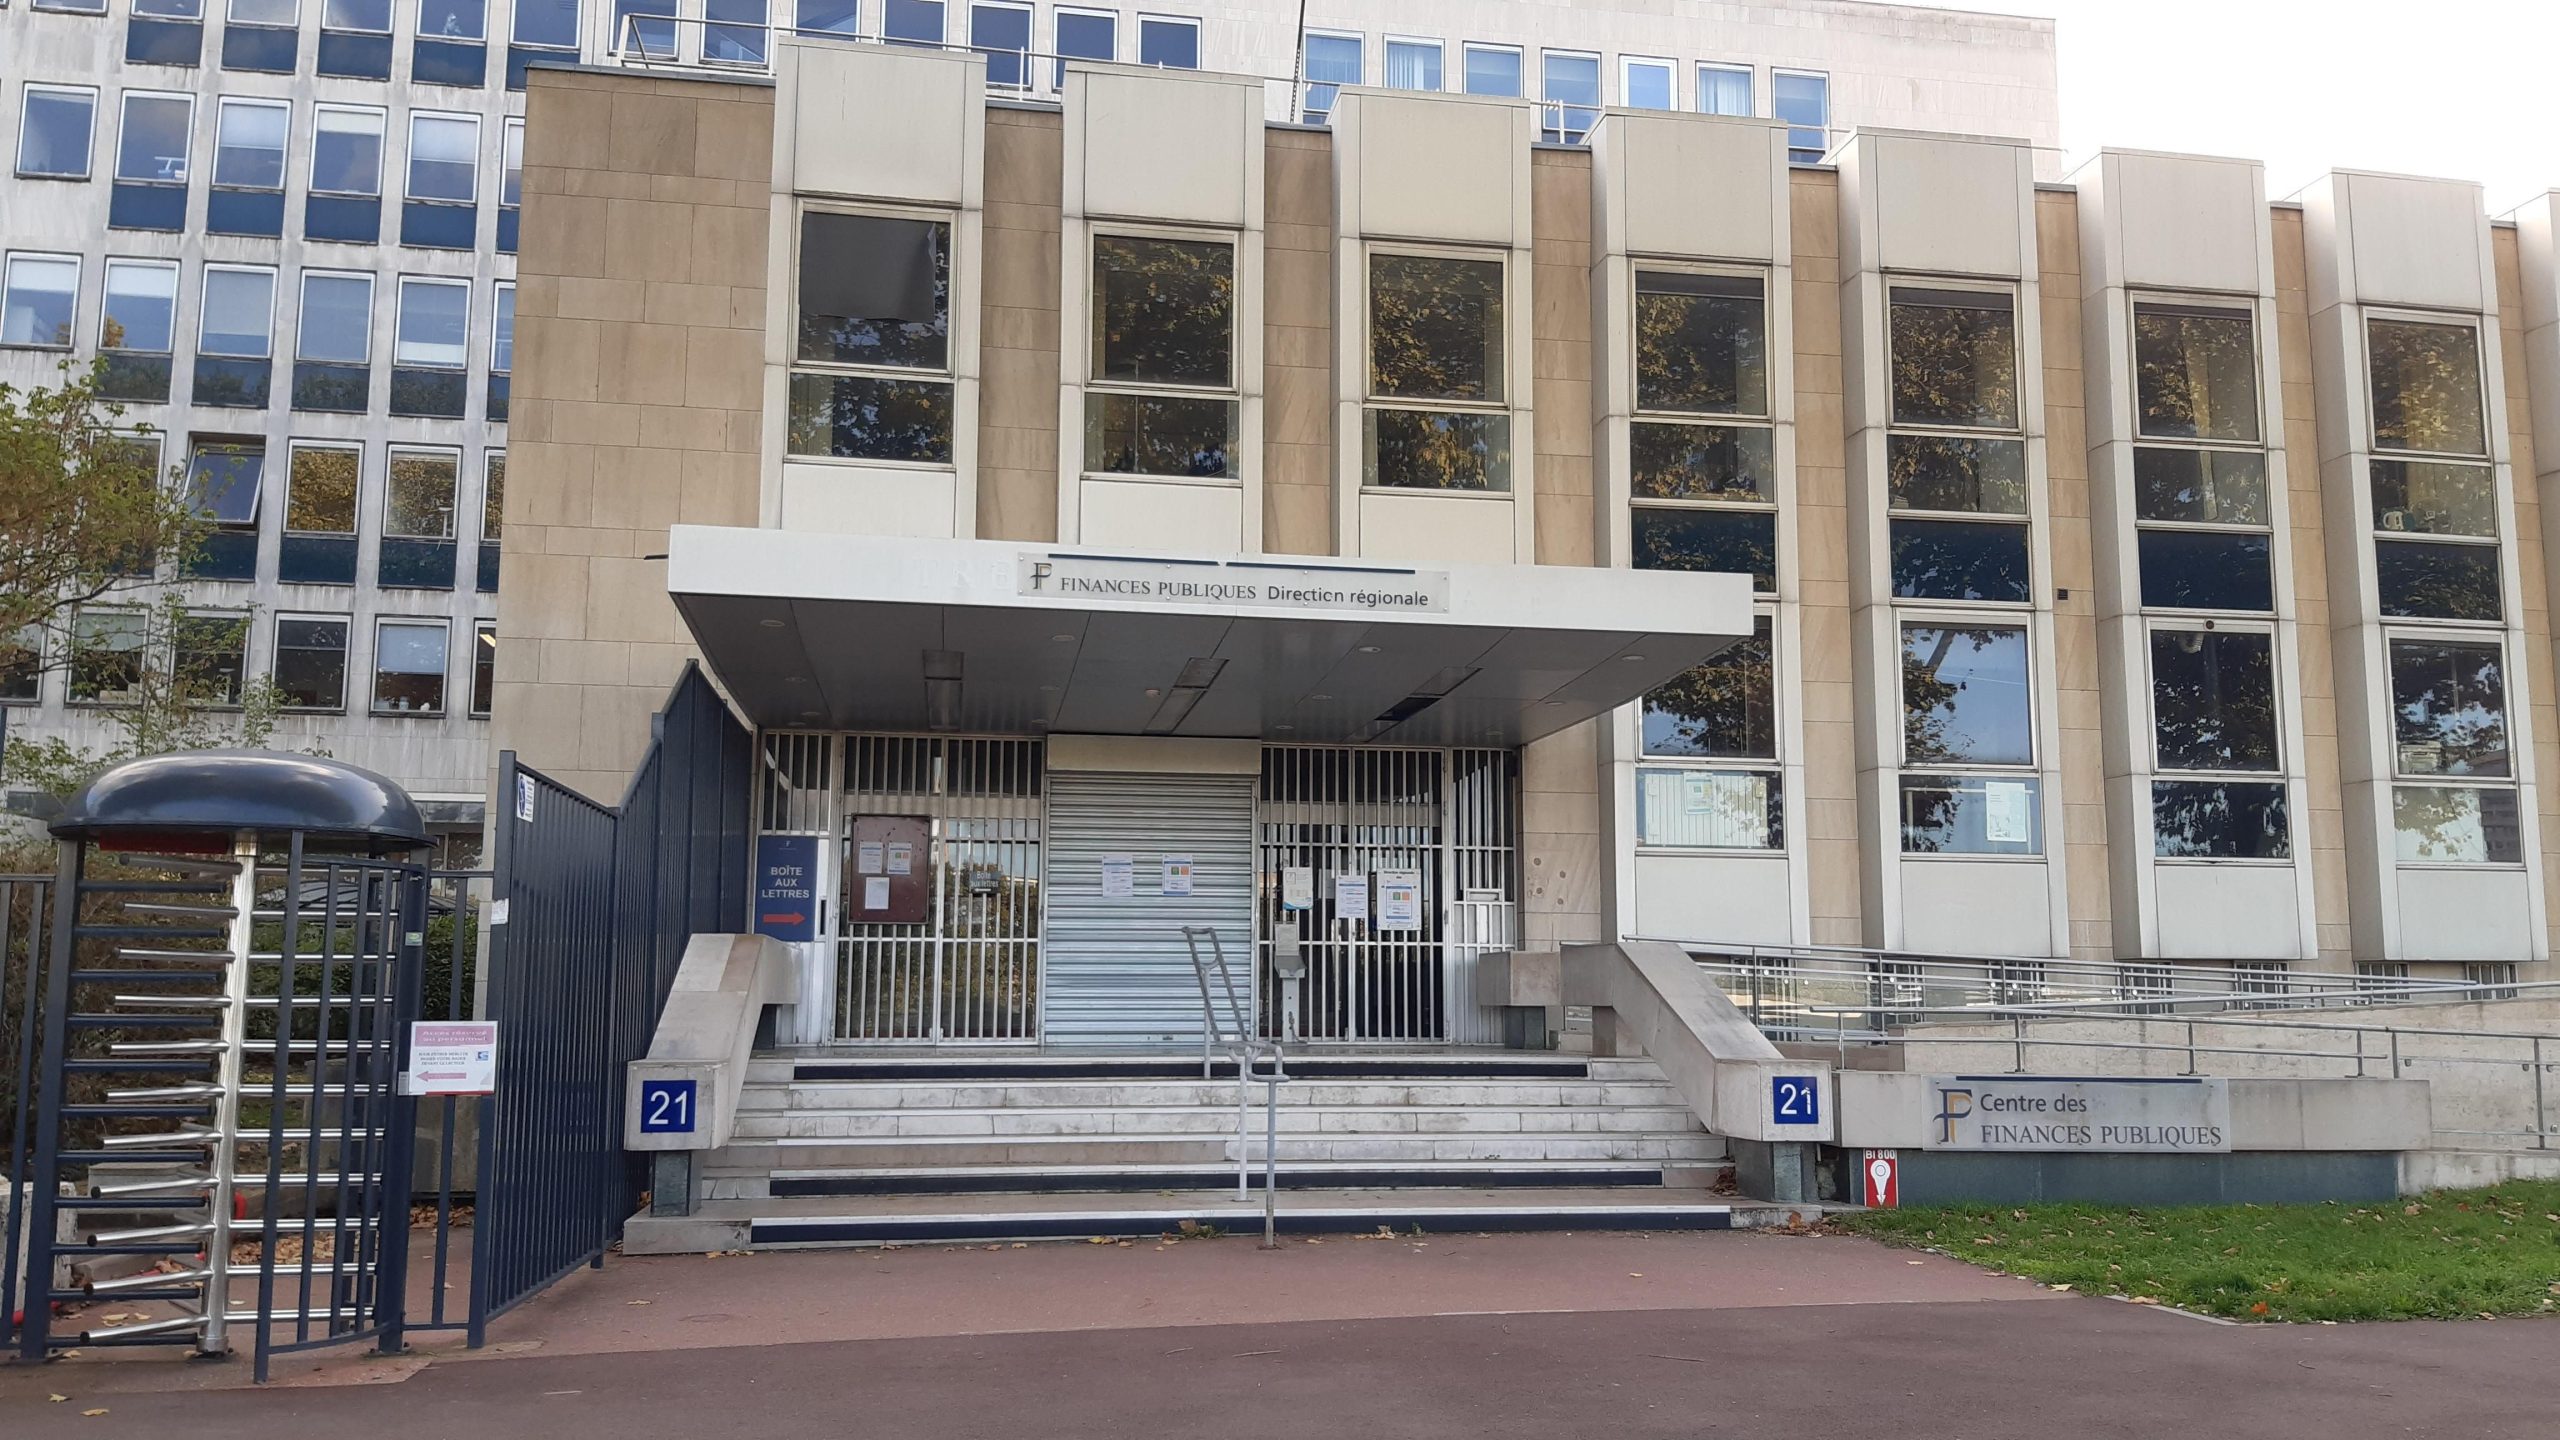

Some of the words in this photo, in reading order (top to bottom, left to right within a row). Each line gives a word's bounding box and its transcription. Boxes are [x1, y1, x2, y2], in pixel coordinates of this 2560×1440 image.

[1060, 577, 1151, 595] FINANCES
[1158, 582, 1257, 600] PUBLIQUES
[1267, 585, 1345, 603] Direction
[1349, 588, 1429, 607] régionale
[770, 865, 803, 876] BOÎTE
[775, 879, 798, 887] AUX
[762, 889, 810, 898] LETTRES
[648, 1090, 687, 1125] 21
[1780, 1083, 1812, 1115] 21
[1980, 1094, 2047, 1112] Centre
[2053, 1094, 2087, 1113] des
[1981, 1125, 2092, 1144] FINANCES
[2099, 1126, 2222, 1148] PUBLIQUES
[1865, 1149, 1876, 1159] BI
[1877, 1149, 1896, 1159] 800
